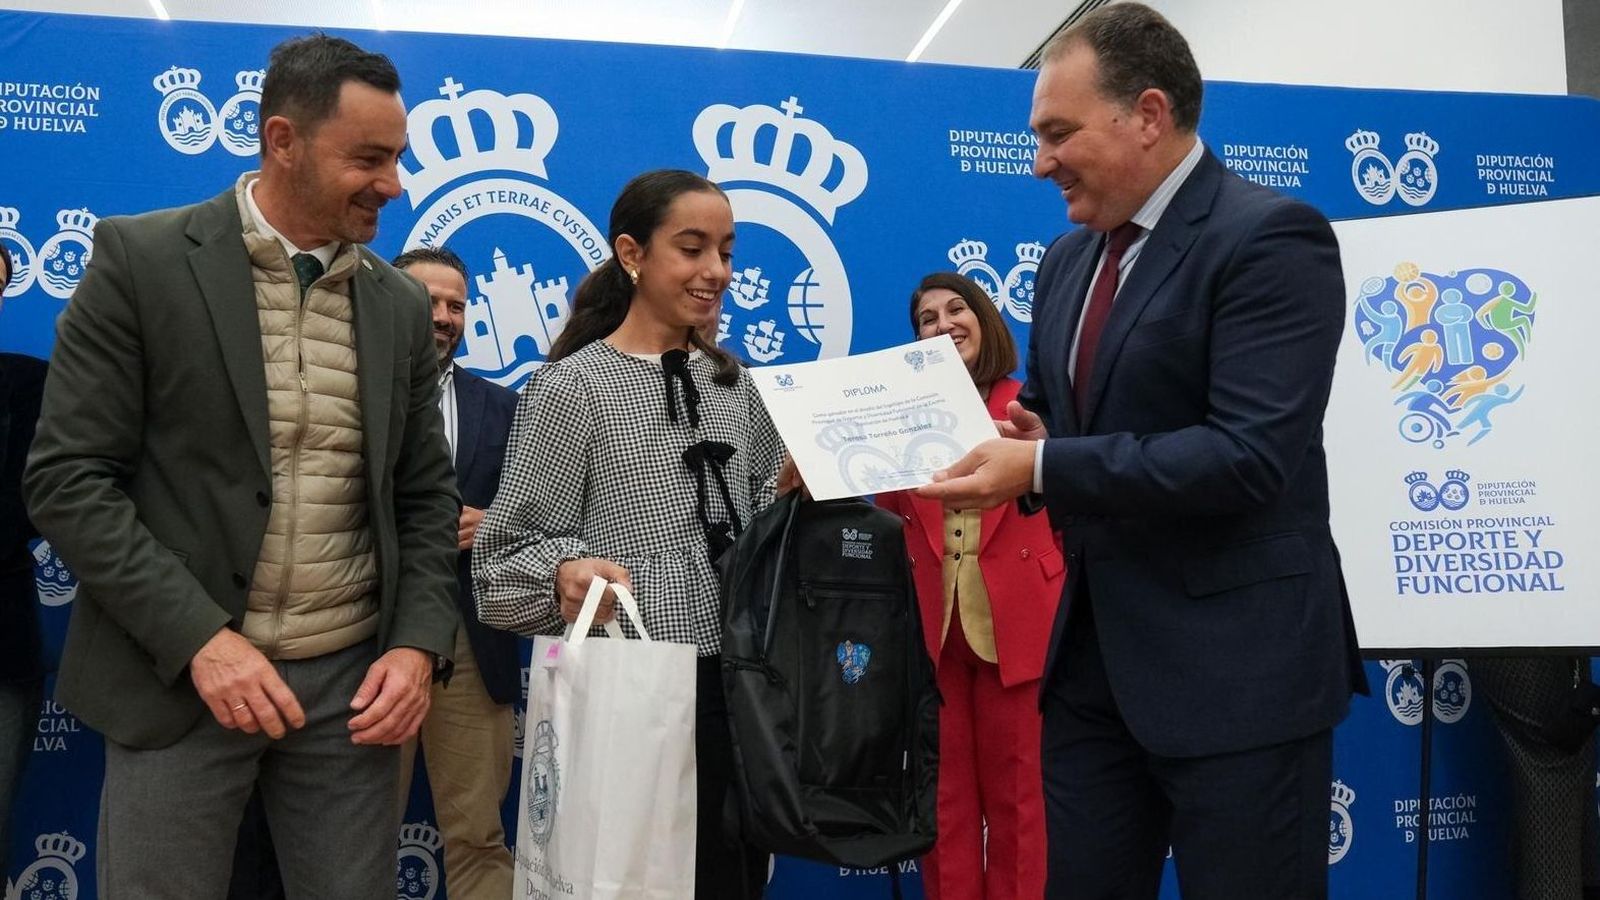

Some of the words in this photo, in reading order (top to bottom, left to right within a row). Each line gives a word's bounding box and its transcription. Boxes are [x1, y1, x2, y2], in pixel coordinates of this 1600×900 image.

[0, 82, 100, 101] IPUTACIÓN
[0, 99, 99, 117] ROVINCIAL
[13, 116, 87, 133] HUELVA
[949, 130, 1039, 147] DIPUTACIÓN
[1223, 144, 1308, 160] DIPUTACIÓN
[975, 160, 1033, 176] HUELVA
[1225, 158, 1309, 174] PROVINCIAL
[1476, 153, 1554, 169] DIPUTACIÓN
[1249, 173, 1302, 187] HUELVA
[1478, 168, 1555, 182] PROVINCIAL
[1499, 183, 1548, 196] HUELVA
[420, 203, 462, 248] MARIS
[463, 193, 482, 211] ET
[486, 190, 551, 214] TERRAE
[843, 383, 887, 398] DIPLOMA
[1477, 478, 1537, 491] DIPUTACIÓN
[1478, 489, 1537, 499] PROVINCIAL
[1489, 496, 1526, 505] HUELVA
[1389, 517, 1462, 532] COMISIÓN
[1466, 516, 1555, 529] PROVINCIAL
[1392, 530, 1519, 552] DEPORTE
[1523, 529, 1543, 548] Y
[1395, 550, 1564, 573] DIVERSIDAD
[1397, 572, 1565, 595] FUNCIONAL
[1428, 826, 1469, 841] UELVA
